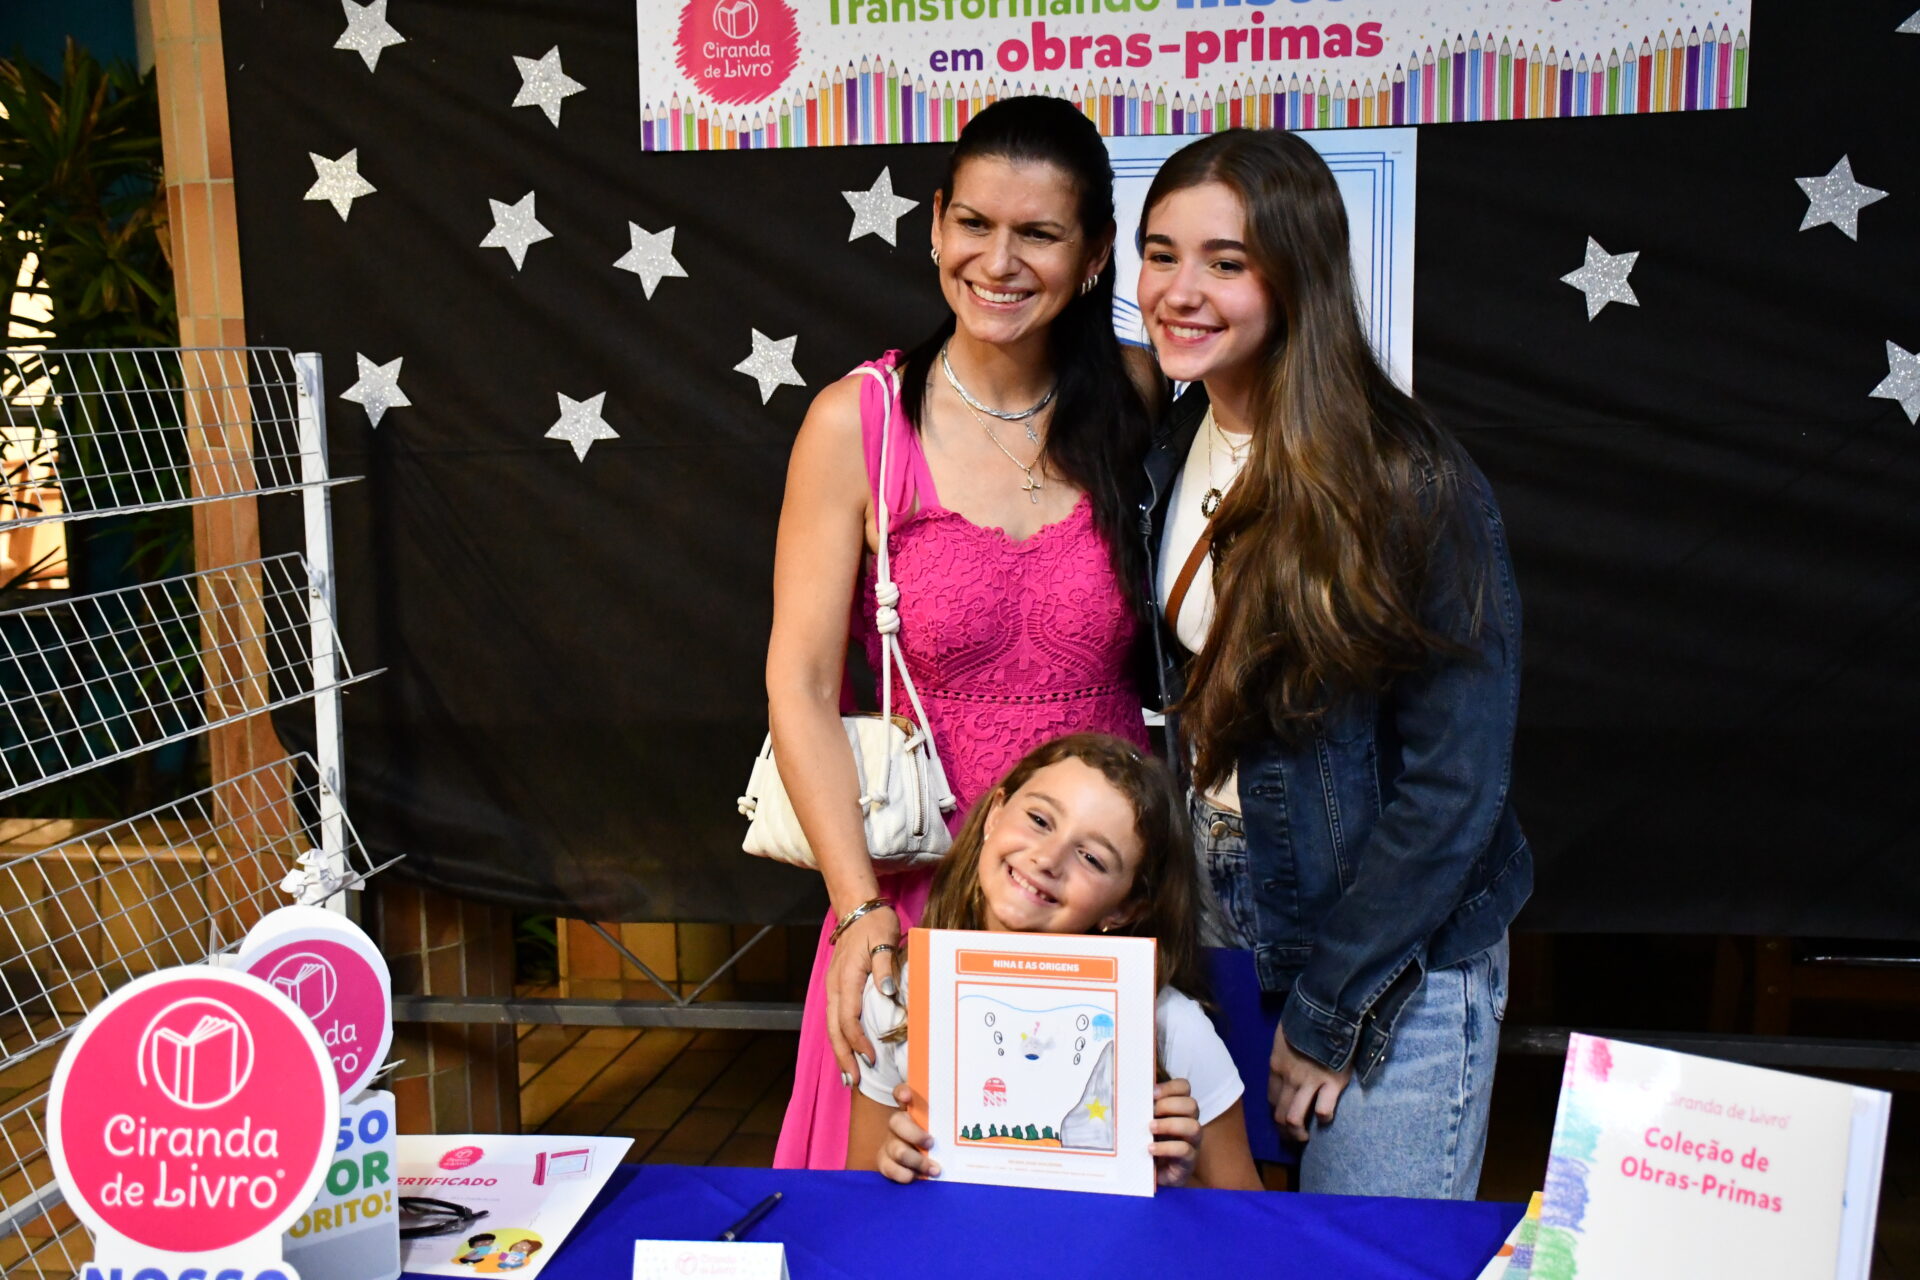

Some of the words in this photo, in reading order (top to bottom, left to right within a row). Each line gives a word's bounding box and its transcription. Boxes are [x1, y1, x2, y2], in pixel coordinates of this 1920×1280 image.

[702, 40, 771, 59] Ciranda
[929, 48, 984, 72] em
[996, 12, 1384, 79] obras-primas
[703, 65, 721, 78] de
[993, 959, 1017, 969] NINA
[1018, 960, 1024, 969] E
[1025, 961, 1038, 970] AS
[1038, 962, 1080, 972] ORIGENS
[1726, 1103, 1745, 1121] de
[103, 1113, 279, 1158] Ciranda
[1644, 1127, 1734, 1164] Coleção
[1740, 1147, 1770, 1172] de
[100, 1172, 145, 1208] de
[397, 1176, 498, 1187] ERTIFICADO
[1620, 1156, 1783, 1213] Obras-Primas
